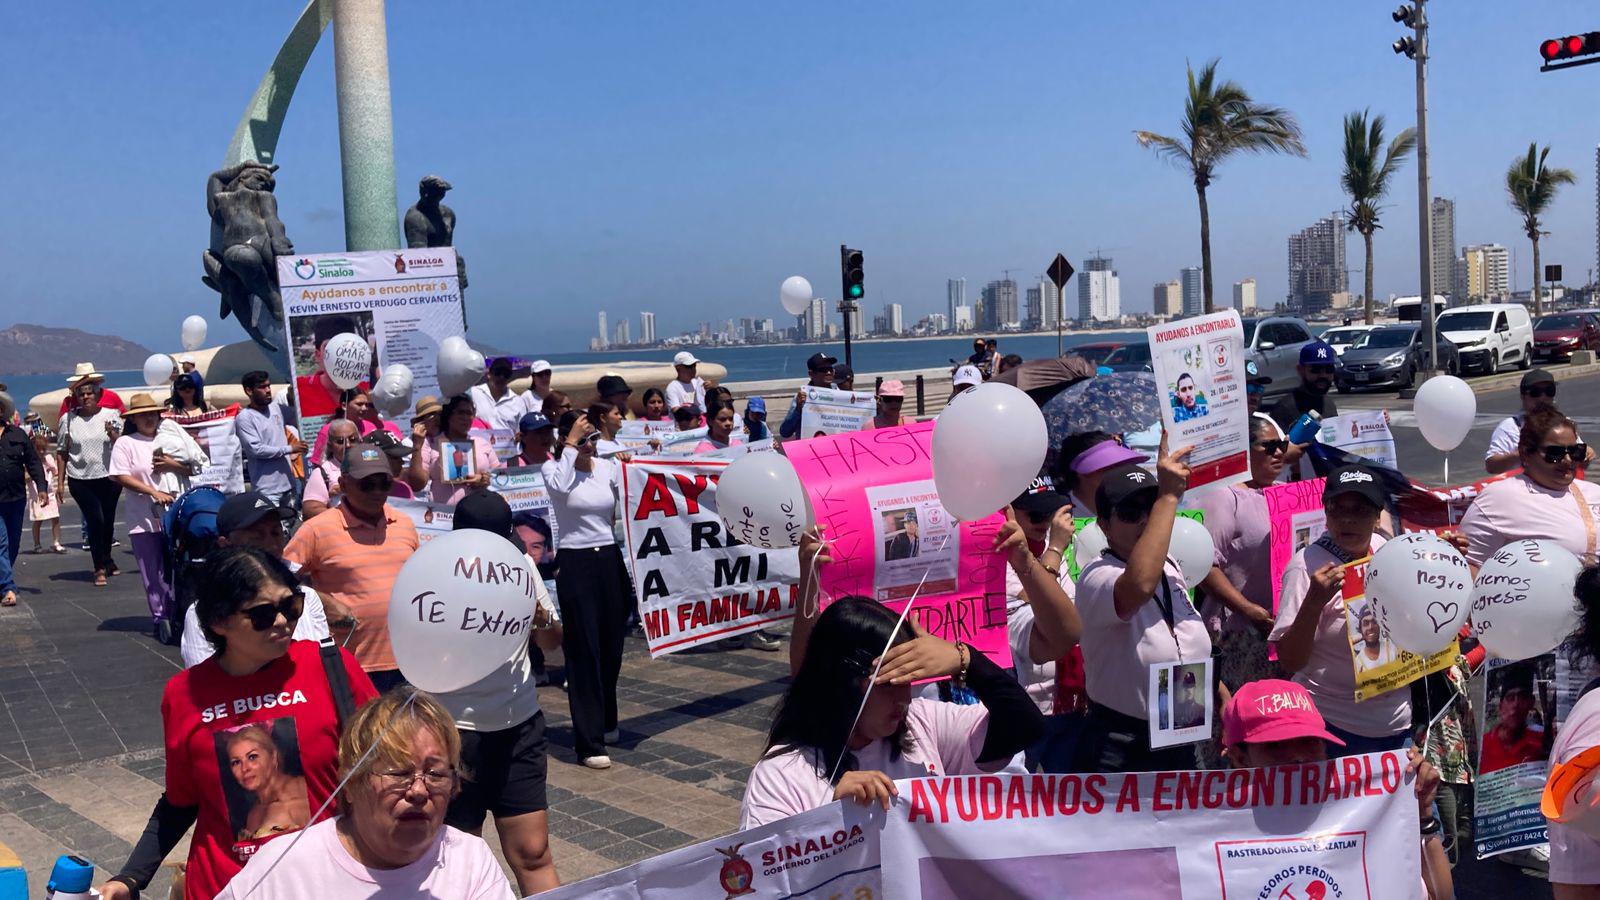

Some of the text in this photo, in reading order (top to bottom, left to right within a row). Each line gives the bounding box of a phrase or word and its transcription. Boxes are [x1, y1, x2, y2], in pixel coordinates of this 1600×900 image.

[318, 268, 354, 278] Sinaloa
[408, 258, 444, 266] SINALOA
[290, 294, 458, 314] KEVIN ERNESTO VERDUGO CERVANTES
[302, 287, 366, 302] Ayúdanos
[368, 288, 376, 296] a
[380, 282, 437, 294] encontrar
[1156, 318, 1236, 344] AYUDANOS A ENCONTRARLO
[336, 347, 365, 361] OMAR
[510, 476, 535, 484] Sinaloa
[634, 472, 720, 521] AY
[911, 493, 939, 504] ENCONTRA
[714, 552, 768, 588] MI
[412, 590, 446, 624] TE
[644, 608, 670, 642] MI
[677, 587, 781, 632] FAMILIA
[202, 690, 308, 724] SE BUSCA
[908, 752, 1402, 824] AYUDANOS A ENCONTRARLO
[762, 824, 863, 866] SINALOA
[1524, 831, 1542, 840] 8424
[764, 836, 865, 877] GOBIERNO DEL ESTADO
[1228, 844, 1299, 858] RASTREADORAS
[1300, 844, 1312, 853] DE
[1298, 865, 1343, 898] PERDIDOS
